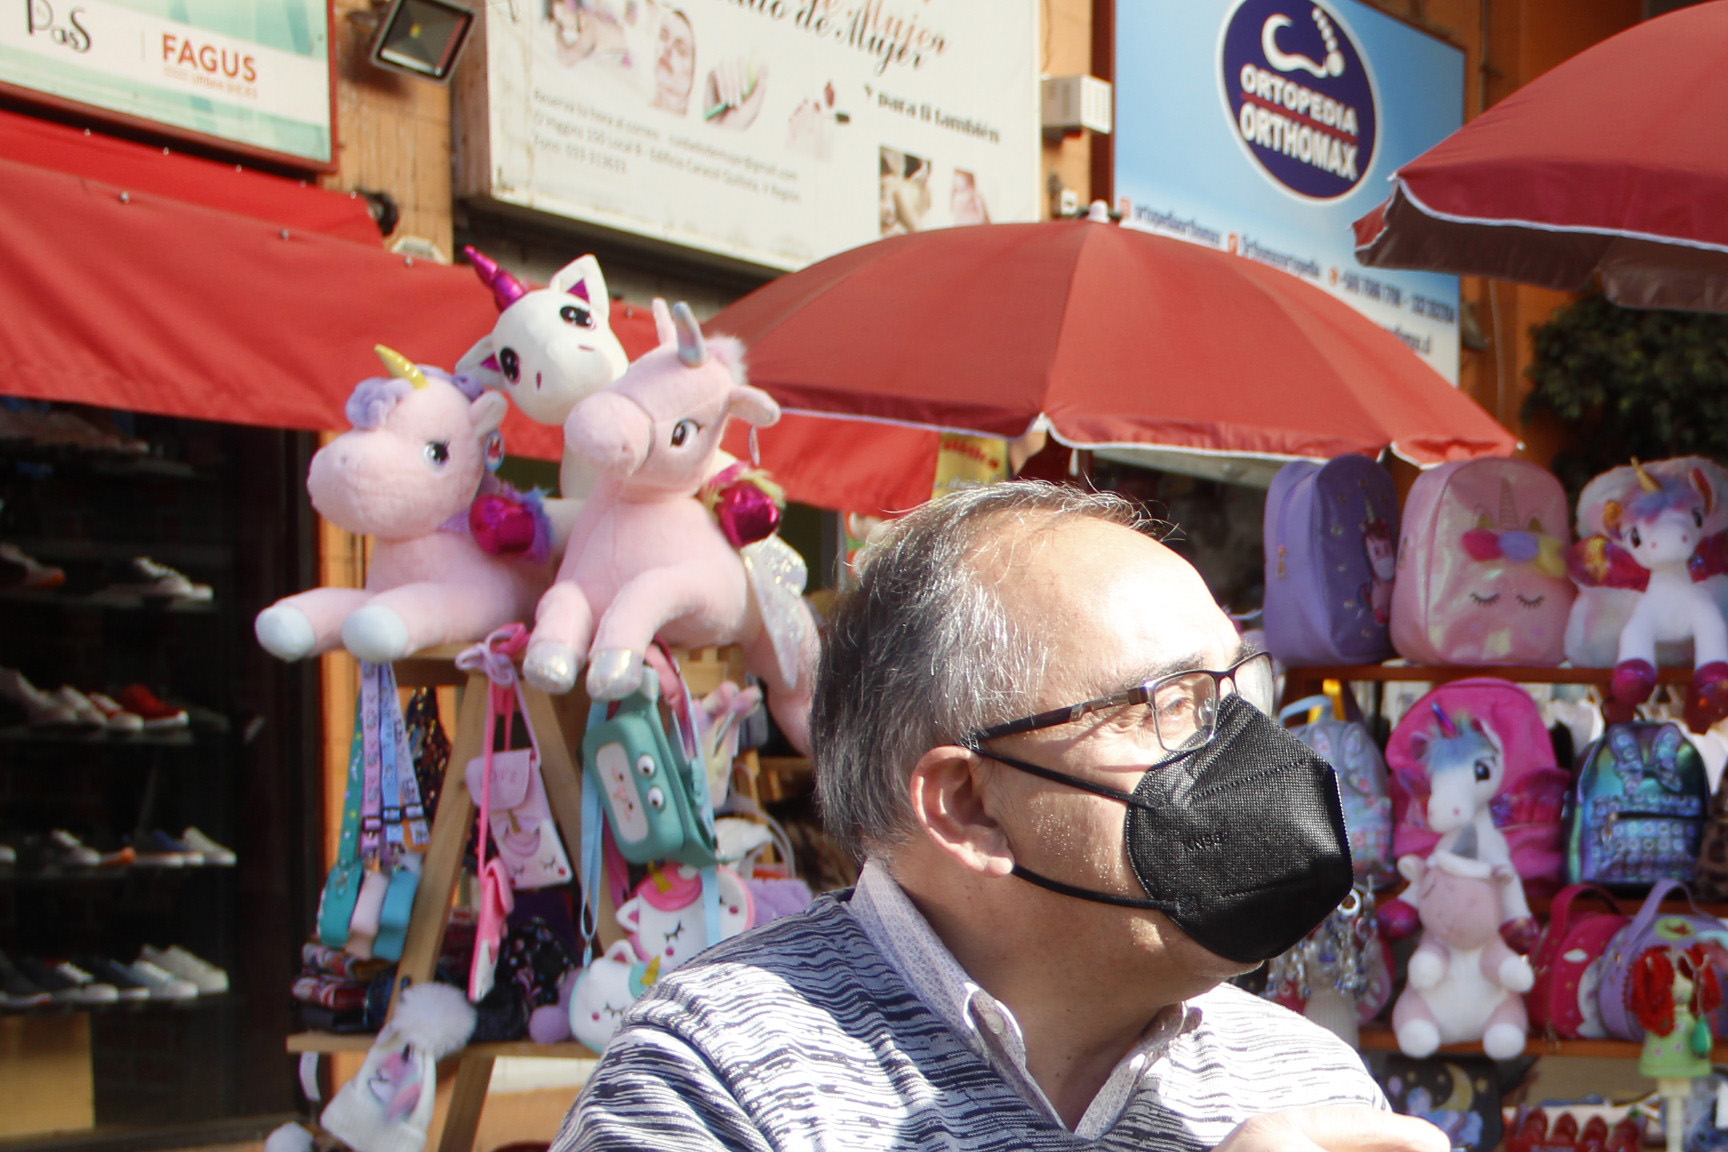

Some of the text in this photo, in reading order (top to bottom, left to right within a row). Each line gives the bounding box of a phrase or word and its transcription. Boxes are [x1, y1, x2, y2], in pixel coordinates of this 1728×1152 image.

[161, 33, 257, 83] FAGUS
[1239, 63, 1359, 136] ORTOPEDIA
[1239, 101, 1359, 181] ORTHOMAX
